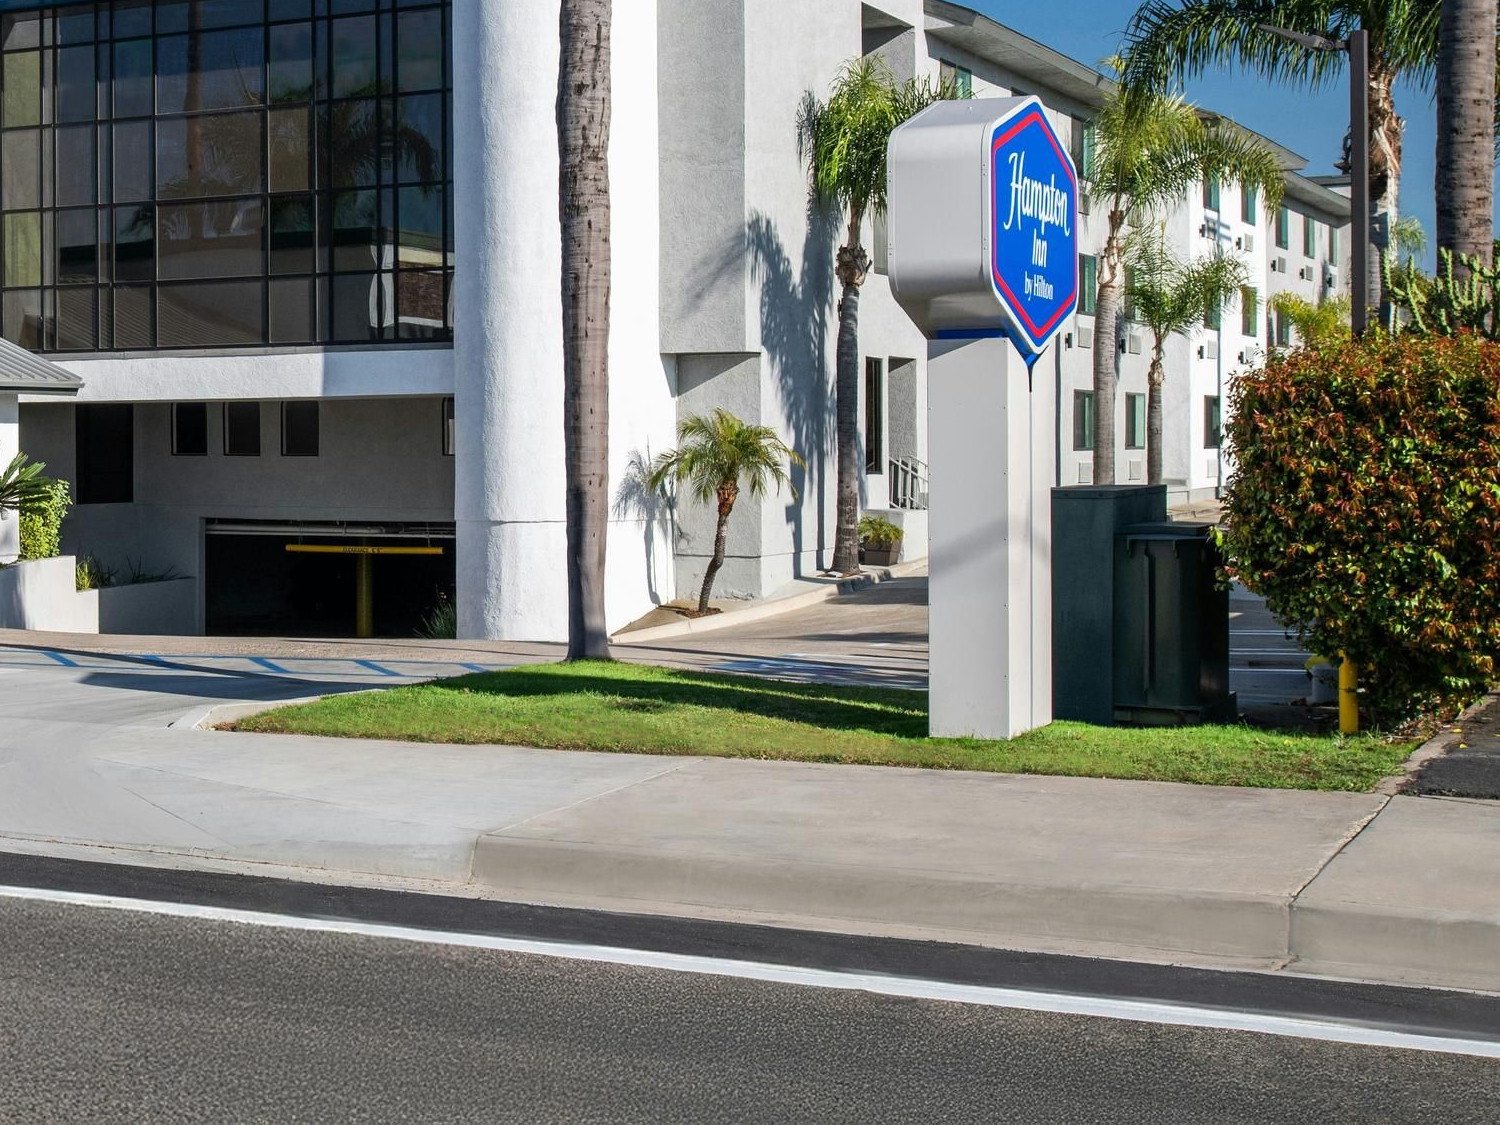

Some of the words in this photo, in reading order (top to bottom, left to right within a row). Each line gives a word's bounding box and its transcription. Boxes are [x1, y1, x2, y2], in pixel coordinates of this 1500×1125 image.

[1003, 150, 1071, 238] Hampton
[1031, 228, 1048, 269] Inn
[1024, 271, 1033, 302] by
[1033, 274, 1054, 301] Hilton
